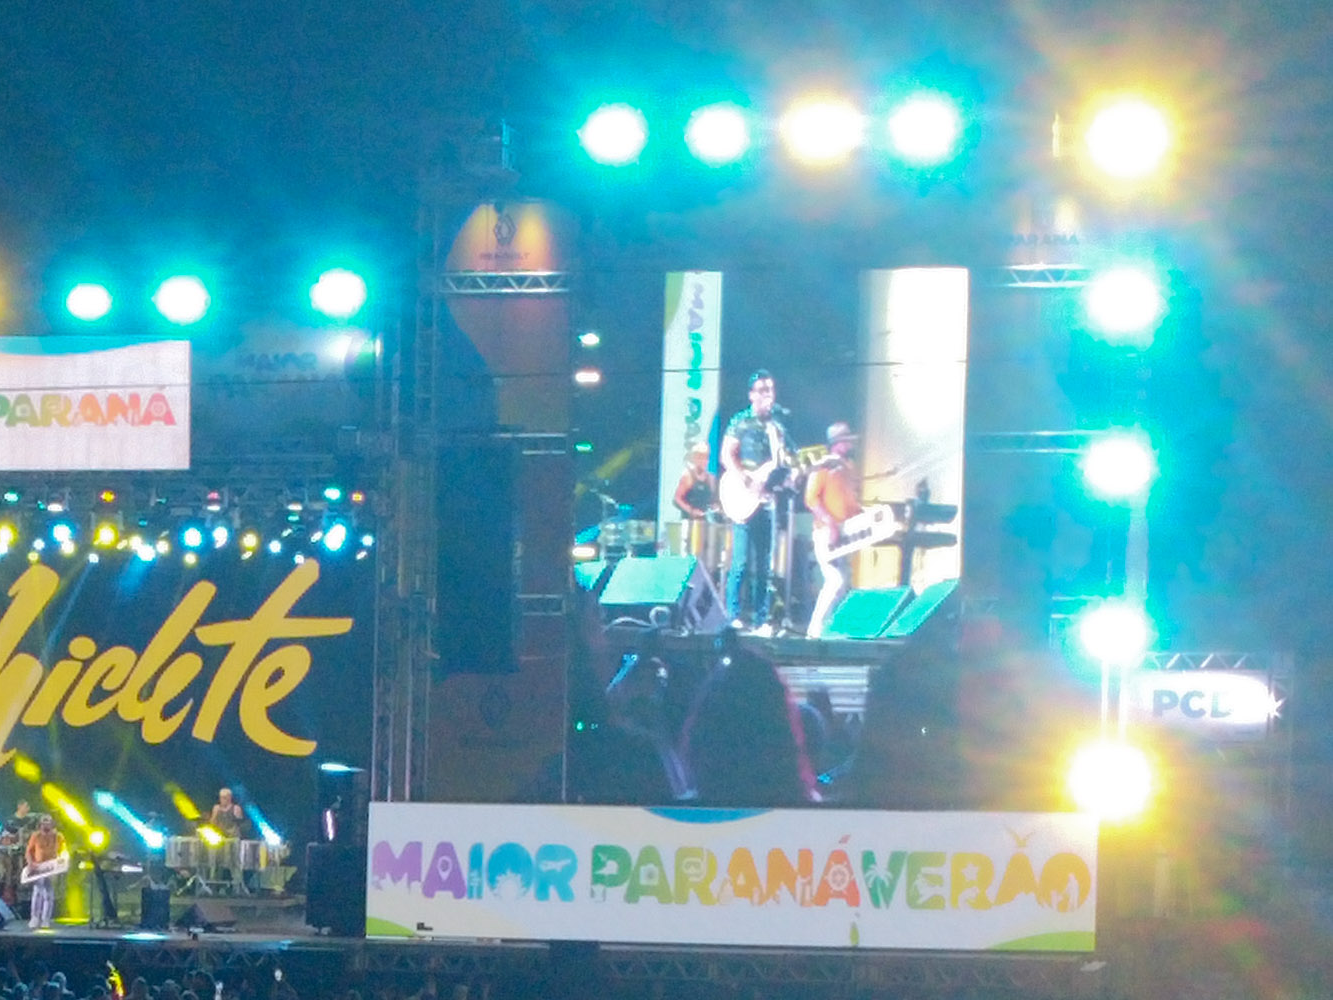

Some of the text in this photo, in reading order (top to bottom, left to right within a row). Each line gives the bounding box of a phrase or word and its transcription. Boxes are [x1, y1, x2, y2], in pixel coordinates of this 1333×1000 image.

[372, 826, 1092, 912] MAIOR PARANÁ VERÃO
